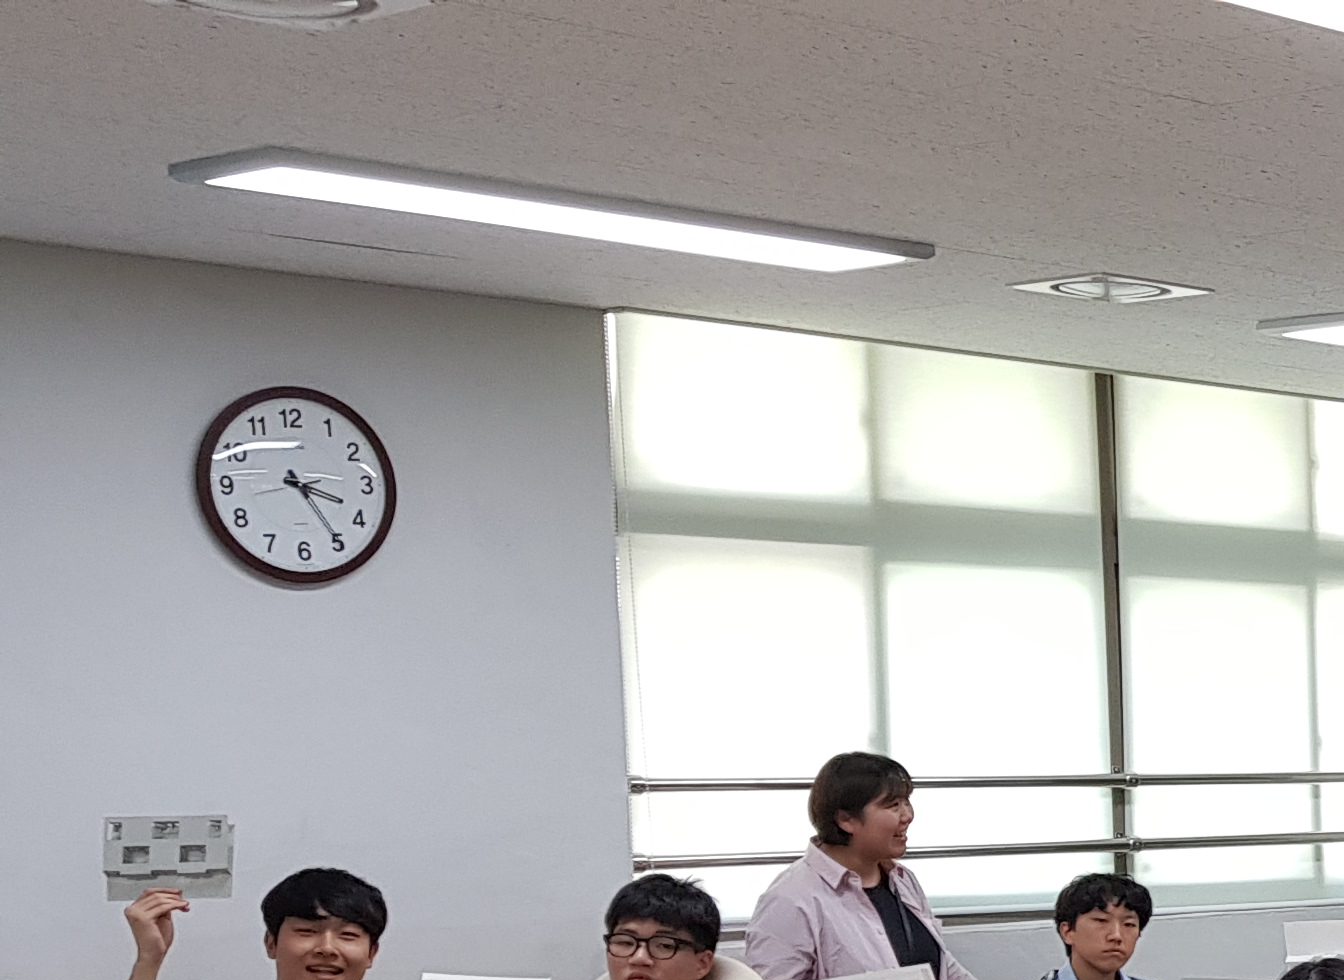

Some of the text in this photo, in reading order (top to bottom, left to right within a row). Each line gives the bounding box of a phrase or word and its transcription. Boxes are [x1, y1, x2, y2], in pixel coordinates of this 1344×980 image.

[247, 416, 267, 436] 11
[278, 408, 303, 429] 12
[323, 418, 332, 437] 1
[223, 442, 247, 463] 10
[346, 442, 361, 462] 2
[219, 475, 234, 495] 9
[360, 475, 374, 495] 3
[233, 508, 249, 528] 8
[352, 509, 366, 529] 4
[262, 533, 276, 553] 7
[297, 541, 312, 561] 6
[331, 532, 345, 552] 5
